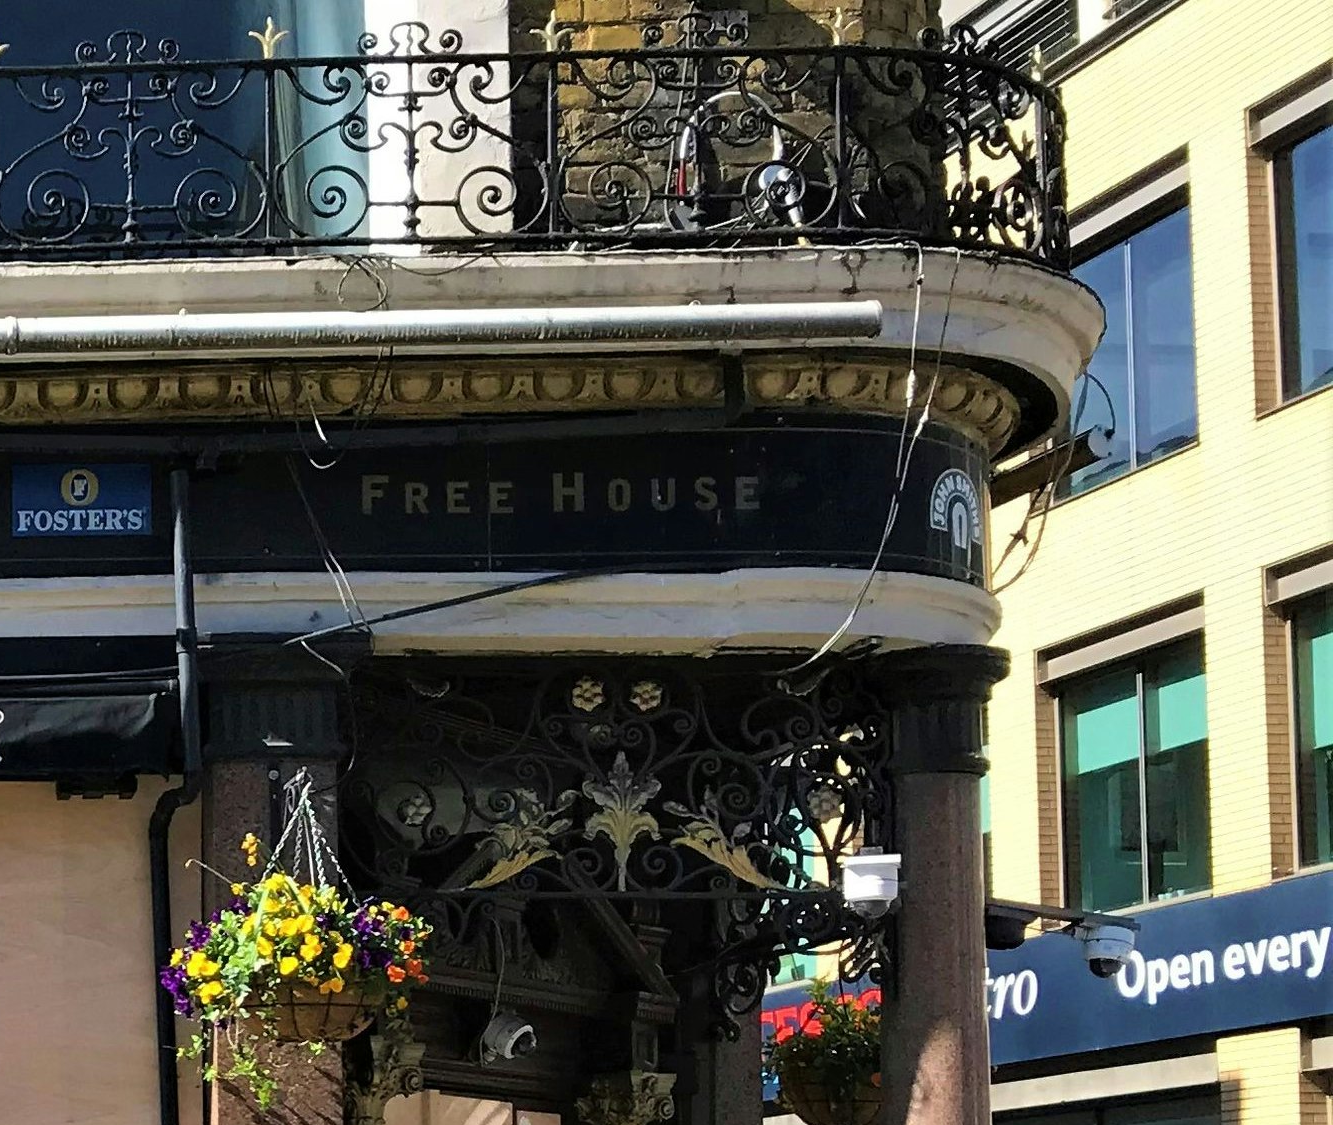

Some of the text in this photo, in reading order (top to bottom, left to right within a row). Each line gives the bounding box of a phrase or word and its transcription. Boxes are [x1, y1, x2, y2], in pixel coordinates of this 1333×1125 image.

[361, 472, 761, 514] FREE HOUSE
[933, 475, 955, 526] JOHN
[16, 508, 144, 532] FOSTER'S
[1116, 926, 1332, 1005] Open every
